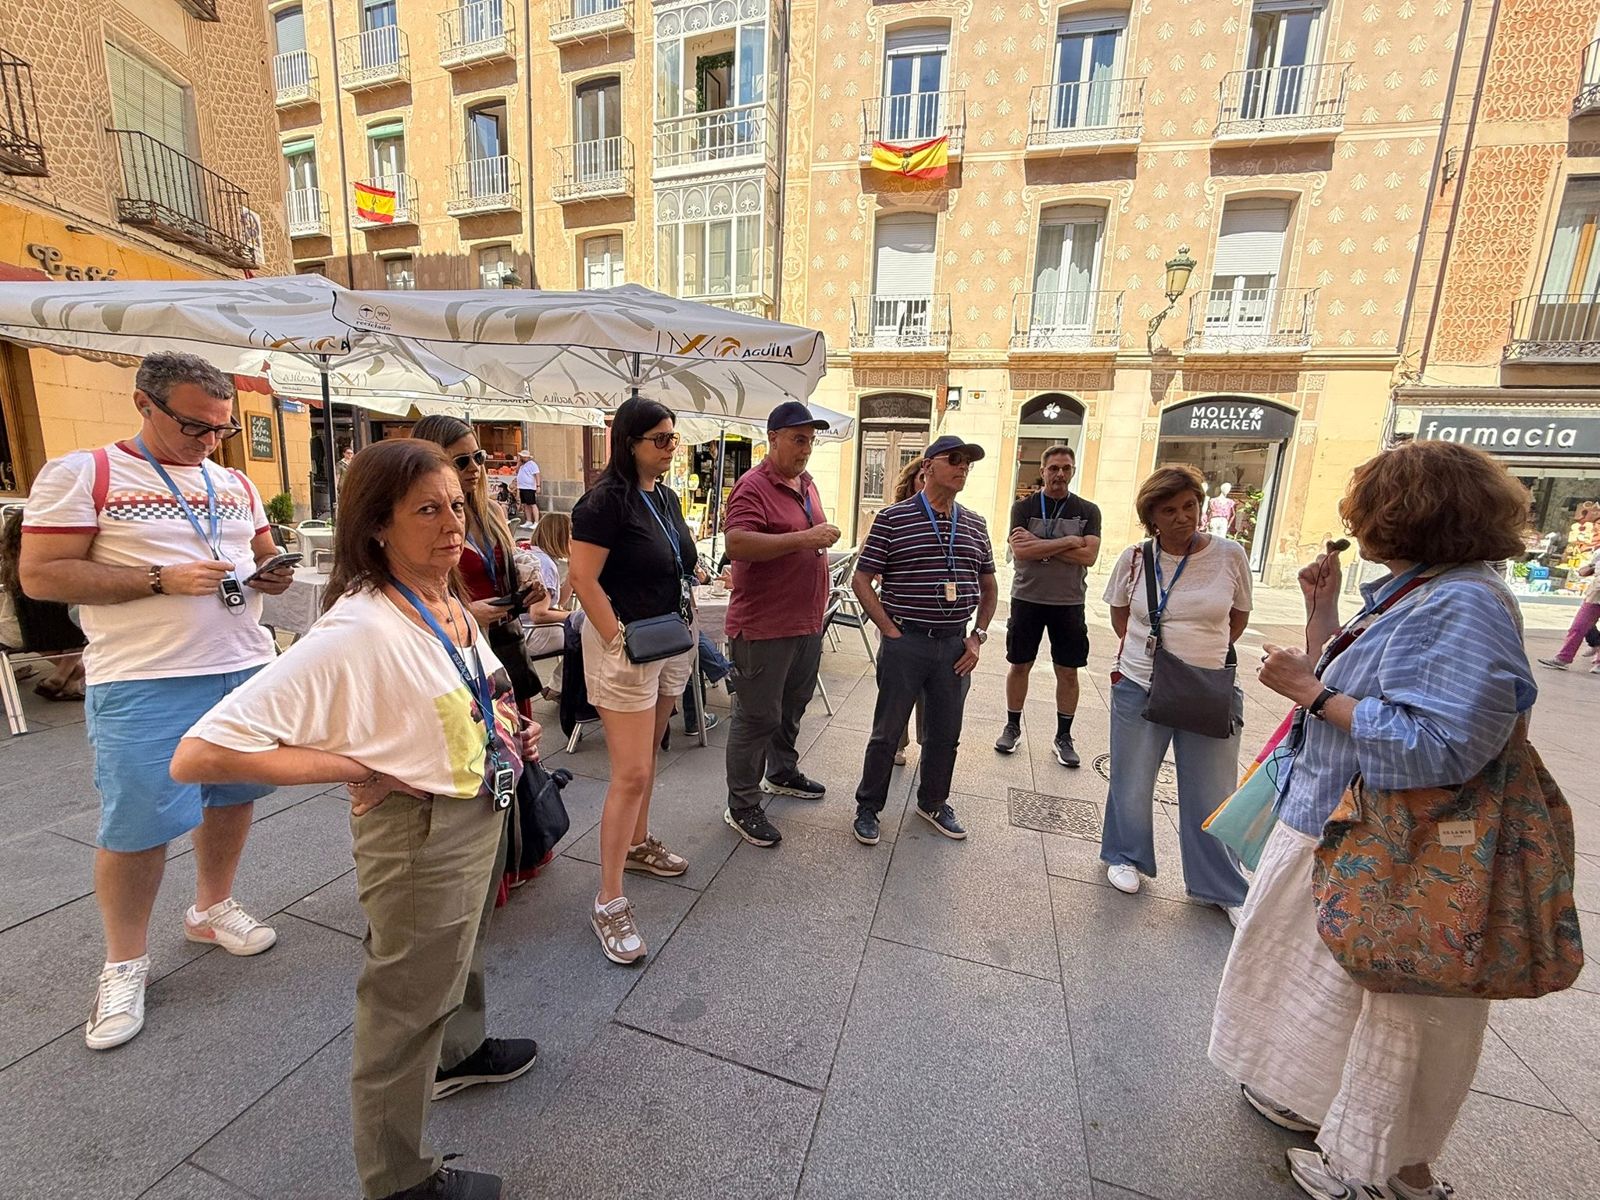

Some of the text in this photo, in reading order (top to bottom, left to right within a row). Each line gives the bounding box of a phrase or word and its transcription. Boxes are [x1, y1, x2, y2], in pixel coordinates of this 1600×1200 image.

[1191, 406, 1248, 419] MOLLY
[1190, 418, 1262, 431] BRACKEN
[1425, 421, 1578, 448] farmacia
